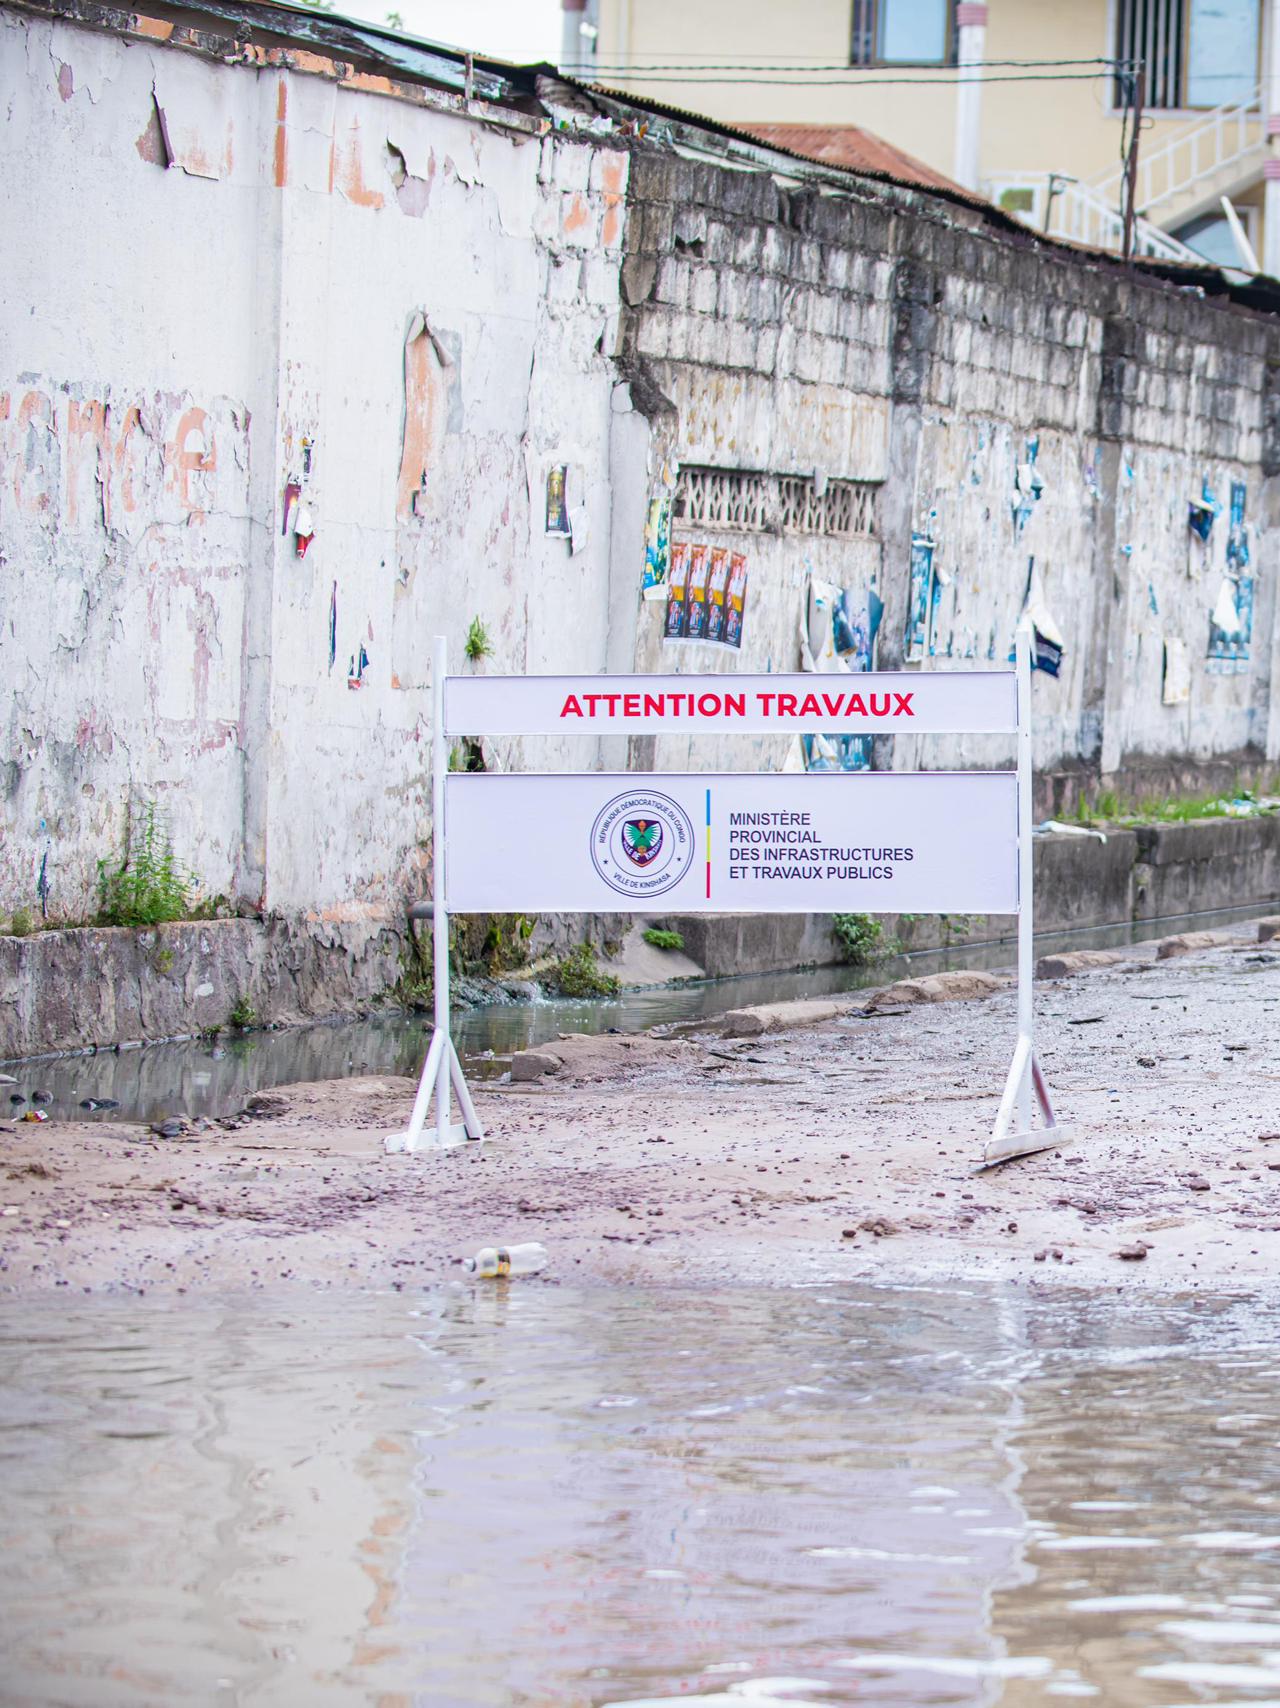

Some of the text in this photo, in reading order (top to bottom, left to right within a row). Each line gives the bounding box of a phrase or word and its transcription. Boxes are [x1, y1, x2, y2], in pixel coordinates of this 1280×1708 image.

[559, 692, 915, 718] ATTENTION TRAVAUX
[599, 807, 622, 843] RÉPUBLIQUE
[729, 809, 811, 826] MINISTÈRE
[729, 830, 822, 844] PROVINCIAL
[729, 848, 914, 862] DES INFRASTRUCTURES
[613, 872, 672, 889] VILLE DE KINSHASA
[729, 866, 894, 880] ET TRAVAUX PUBLICS
